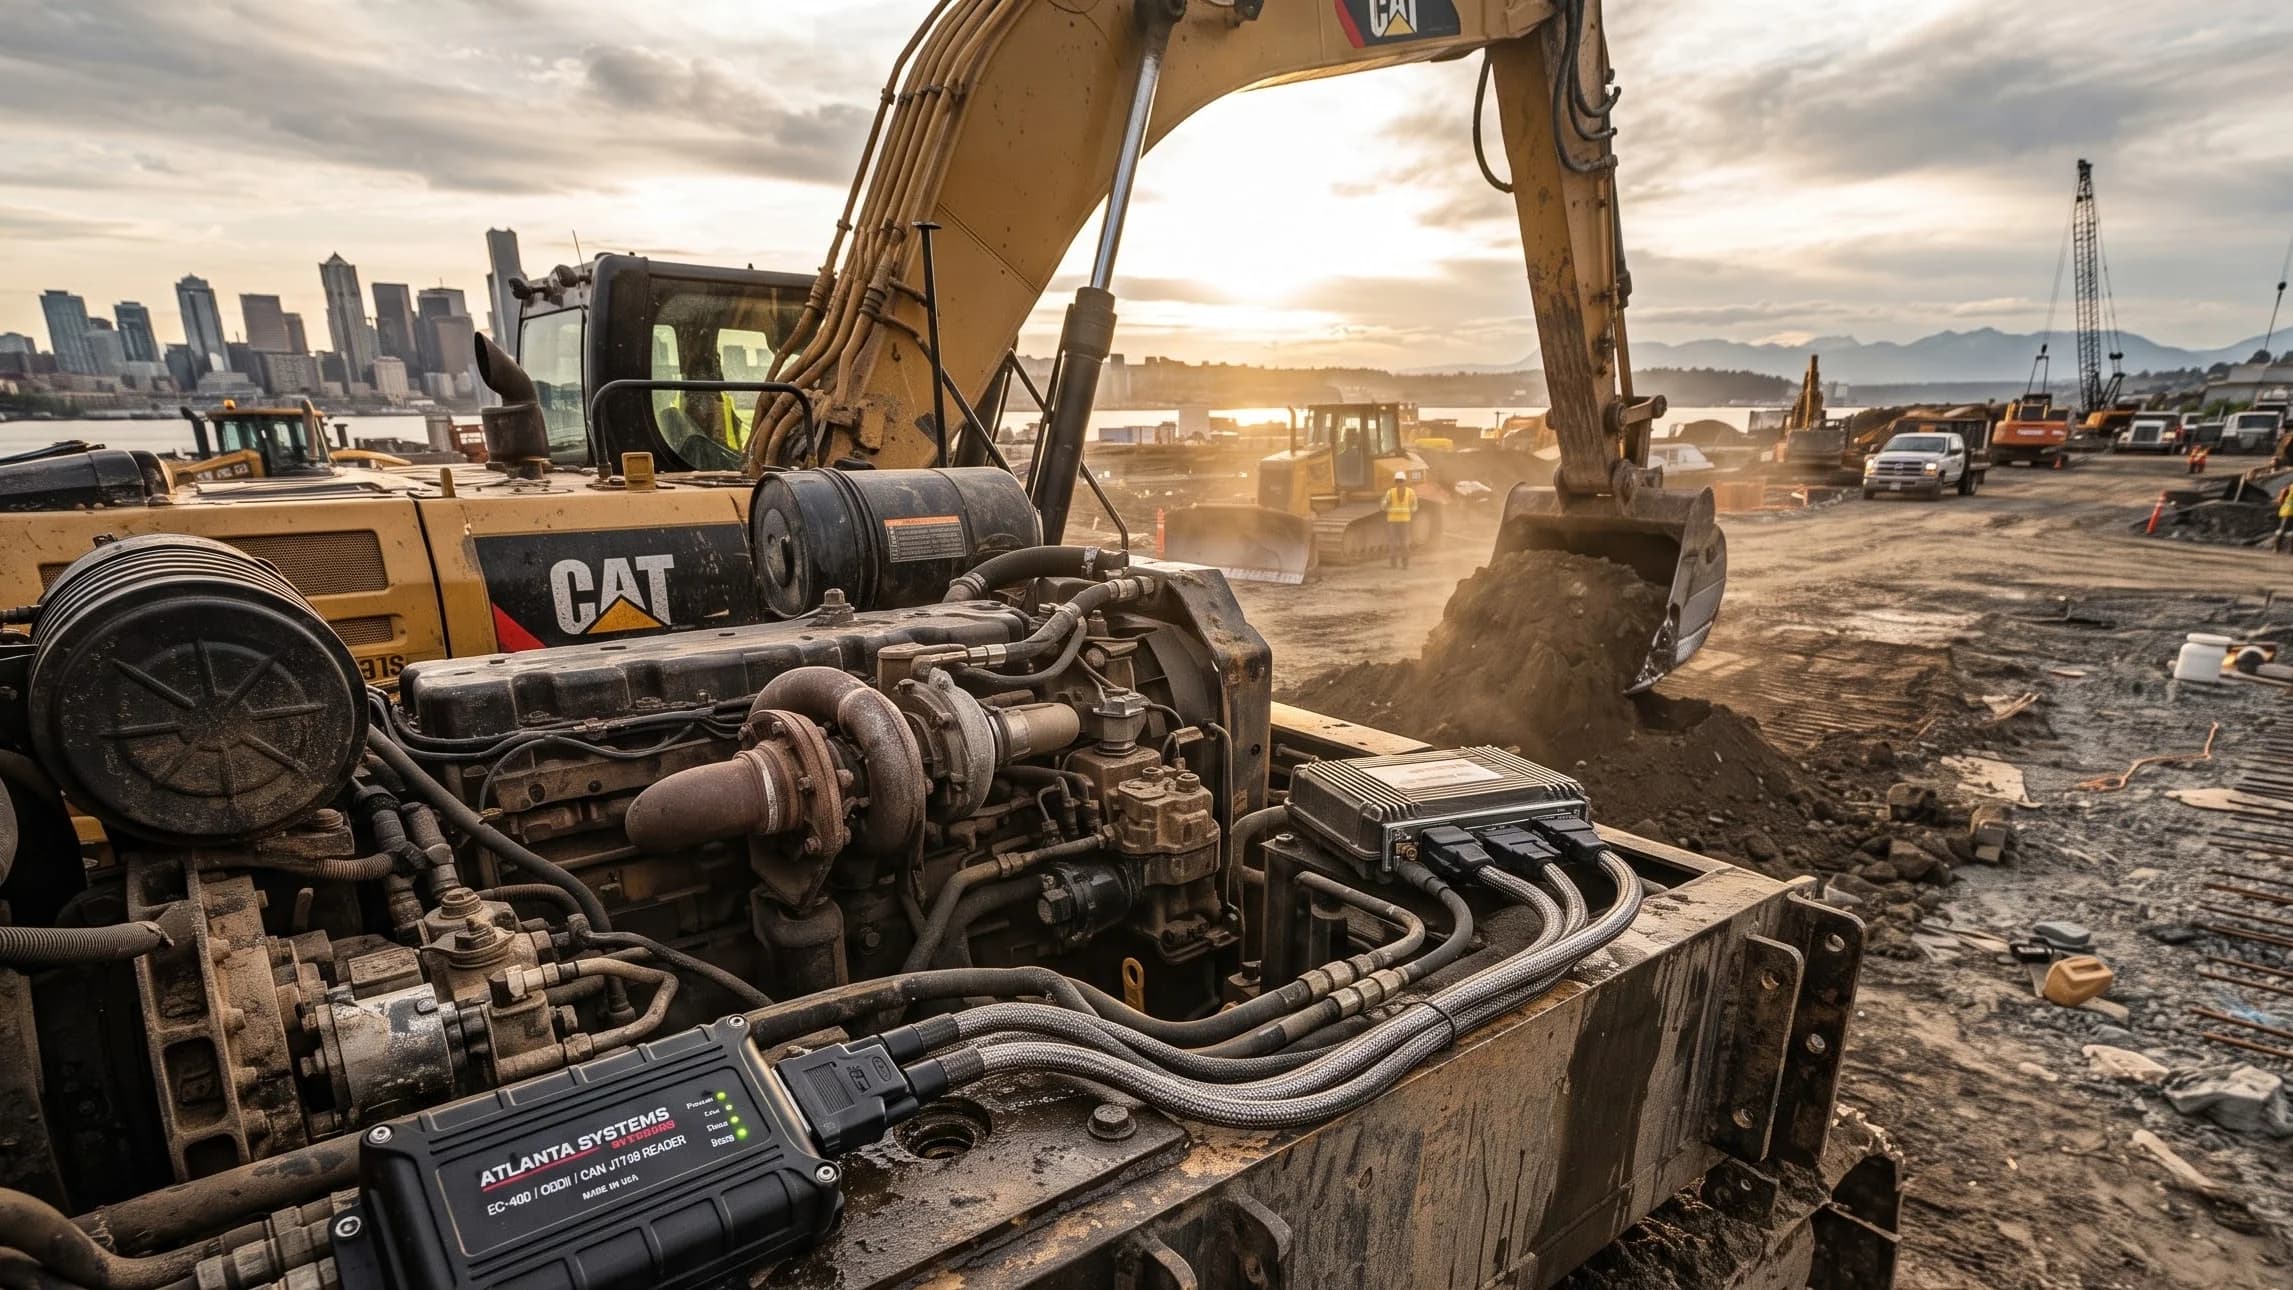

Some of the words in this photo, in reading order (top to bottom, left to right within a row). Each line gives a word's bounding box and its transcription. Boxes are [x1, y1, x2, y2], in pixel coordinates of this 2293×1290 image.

[550, 554, 675, 635] CAT
[480, 1142, 576, 1188] ATLANTA
[577, 1106, 671, 1151] SYSTEMS
[580, 1163, 607, 1180] CAN
